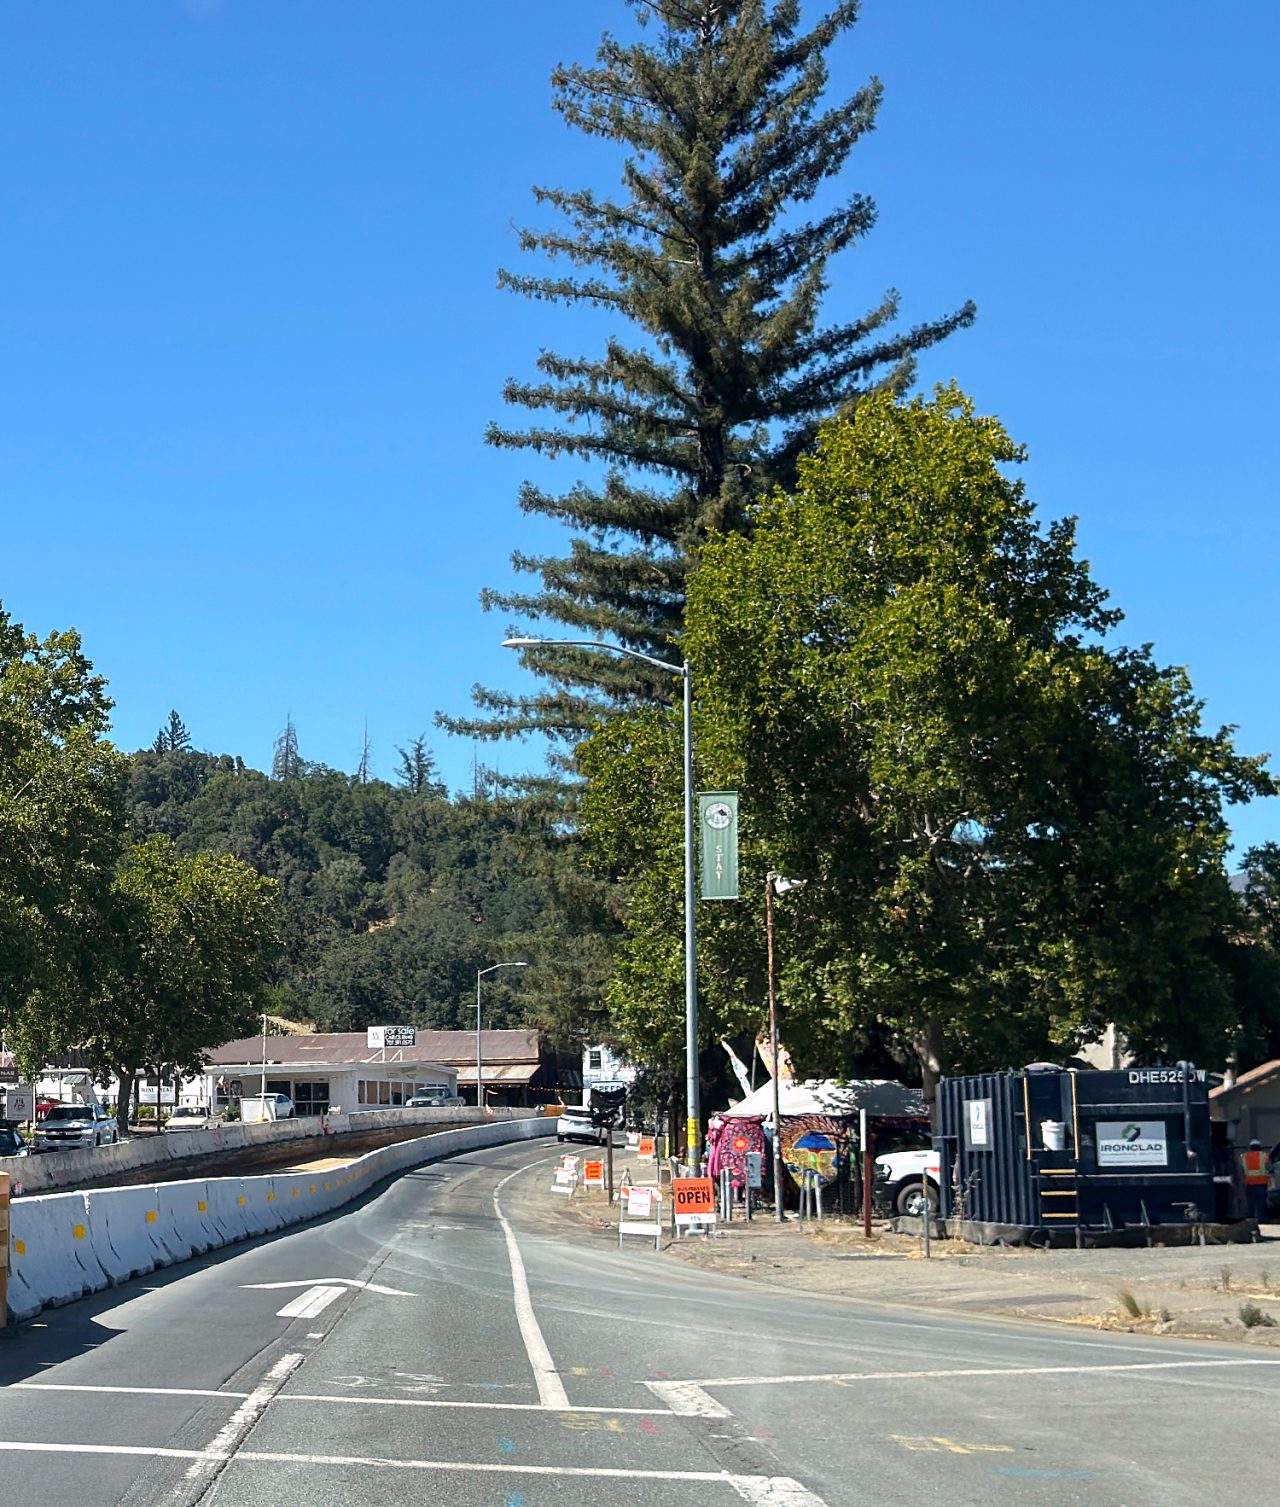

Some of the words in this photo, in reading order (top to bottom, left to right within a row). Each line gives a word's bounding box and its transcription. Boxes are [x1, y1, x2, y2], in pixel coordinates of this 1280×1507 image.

[715, 845, 723, 880] STAY
[1100, 1143, 1163, 1152] IRONCLAD
[677, 1191, 711, 1205] OPEN
